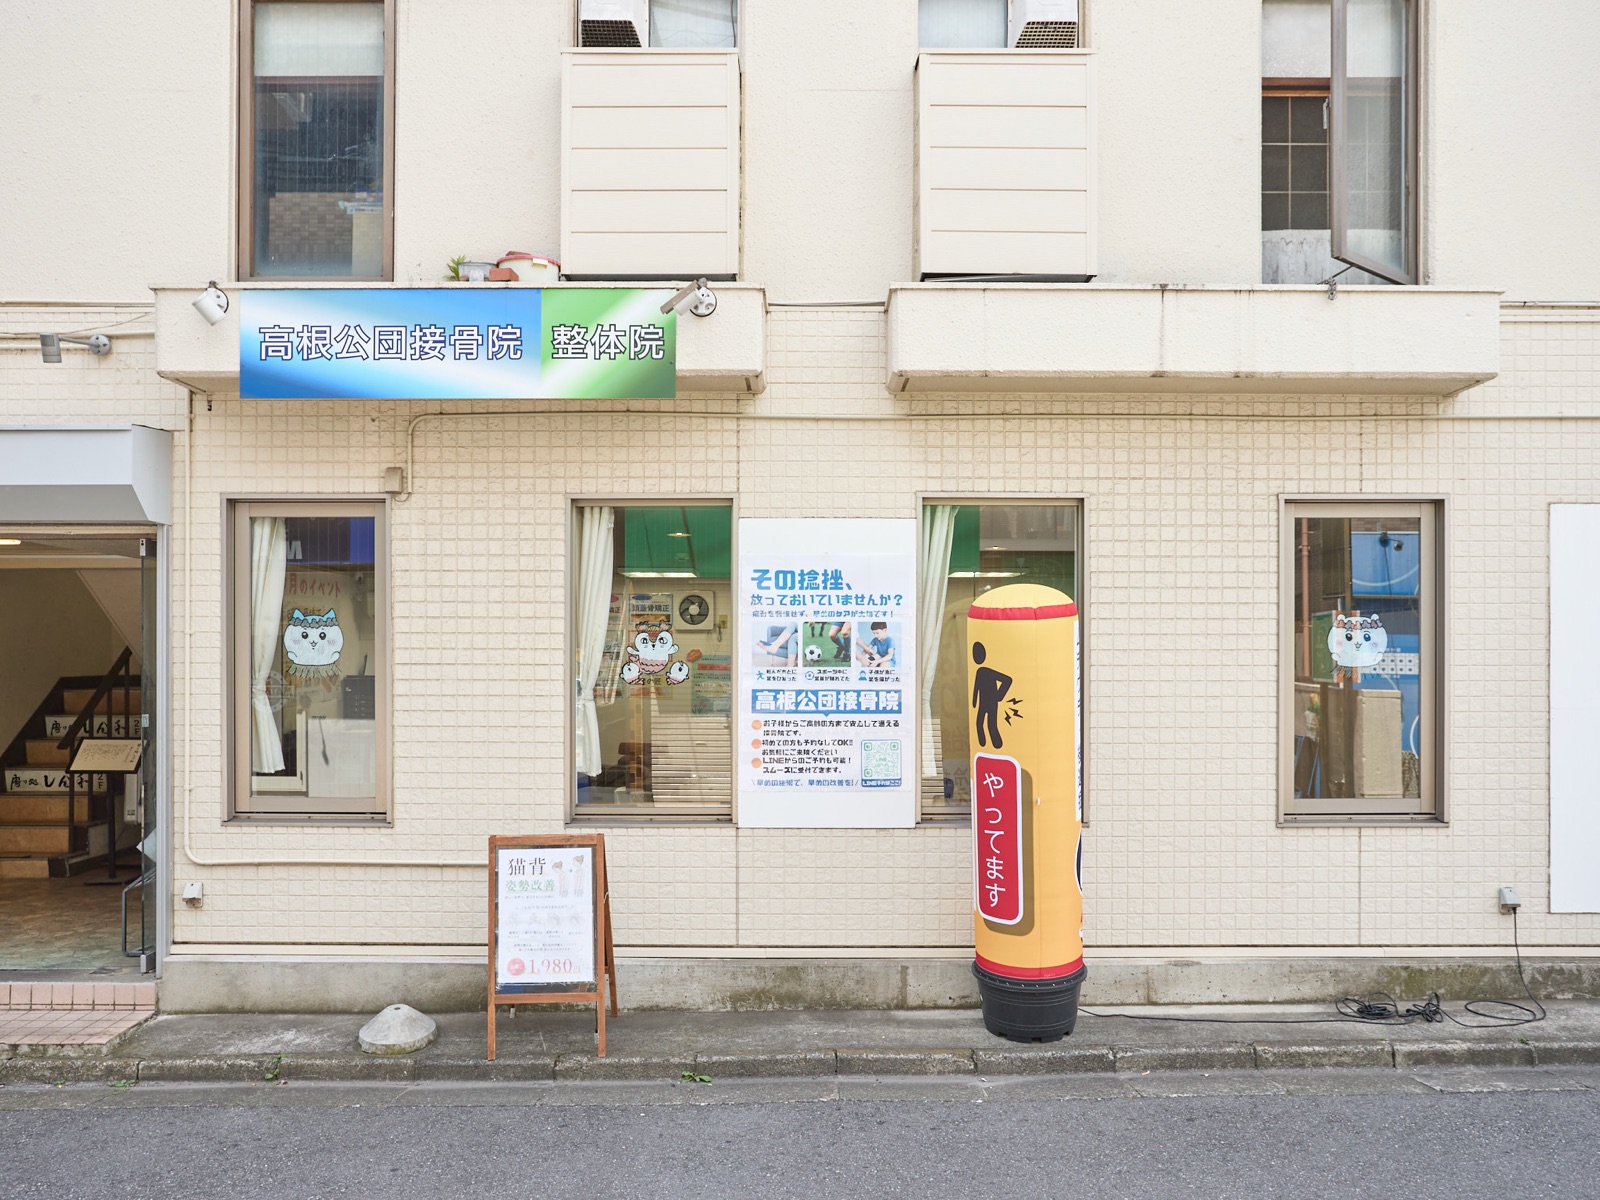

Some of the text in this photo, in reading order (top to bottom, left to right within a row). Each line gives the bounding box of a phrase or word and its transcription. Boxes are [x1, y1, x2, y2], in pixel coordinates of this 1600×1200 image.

[258, 324, 665, 361] 高根公団接骨院 整体院
[284, 571, 341, 598] 月のイベント
[751, 569, 852, 591] その捻挫、
[755, 690, 899, 711] 高根公団接骨院
[982, 772, 1006, 908] やってます
[507, 857, 547, 876] 猫背
[505, 879, 556, 893] 姿勢改善
